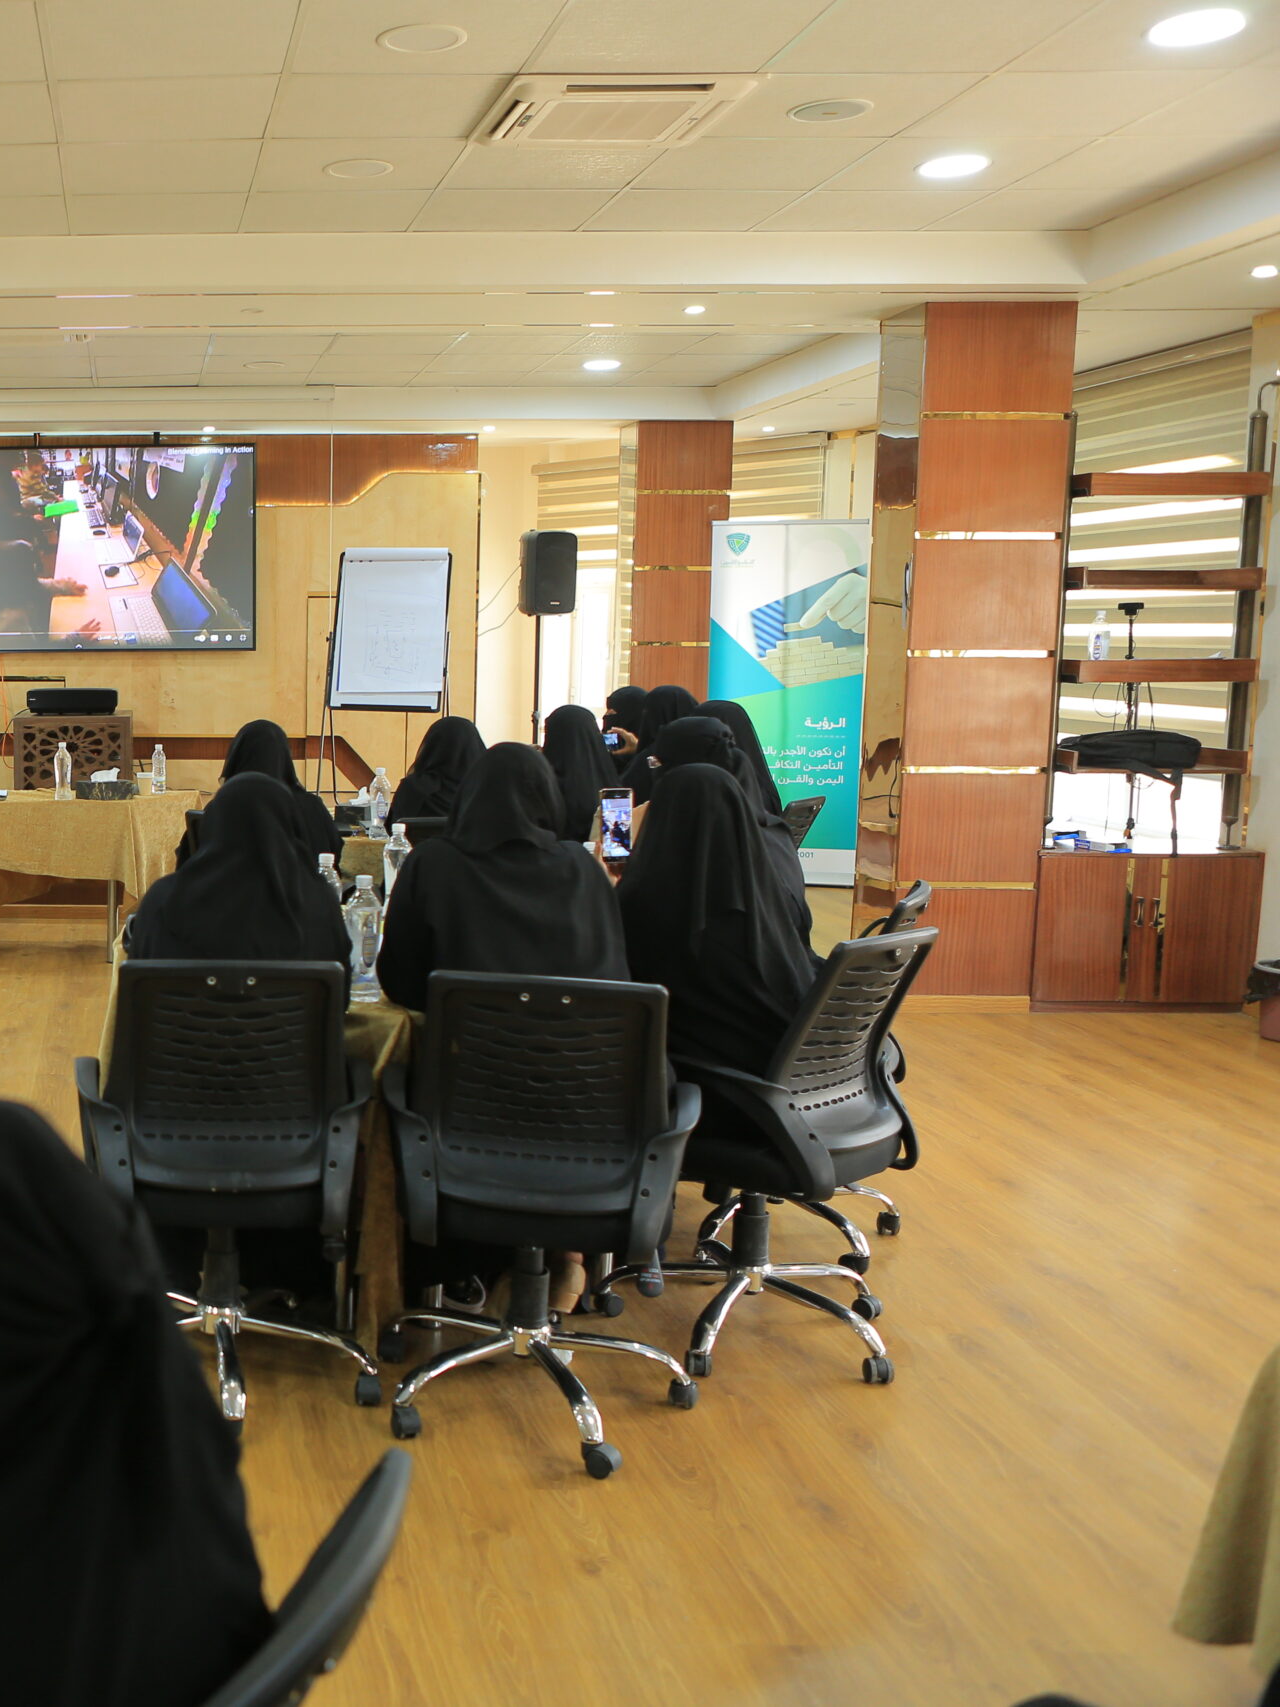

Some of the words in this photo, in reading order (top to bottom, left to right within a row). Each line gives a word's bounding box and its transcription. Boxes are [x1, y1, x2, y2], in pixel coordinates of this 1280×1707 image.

[804, 716, 846, 730] الرؤية
[779, 745, 806, 757] الأجدر
[808, 746, 832, 758] نكون
[834, 745, 846, 758] أن
[803, 759, 843, 772] التأمين
[777, 774, 814, 786] والقرن
[816, 775, 844, 786] اليمن
